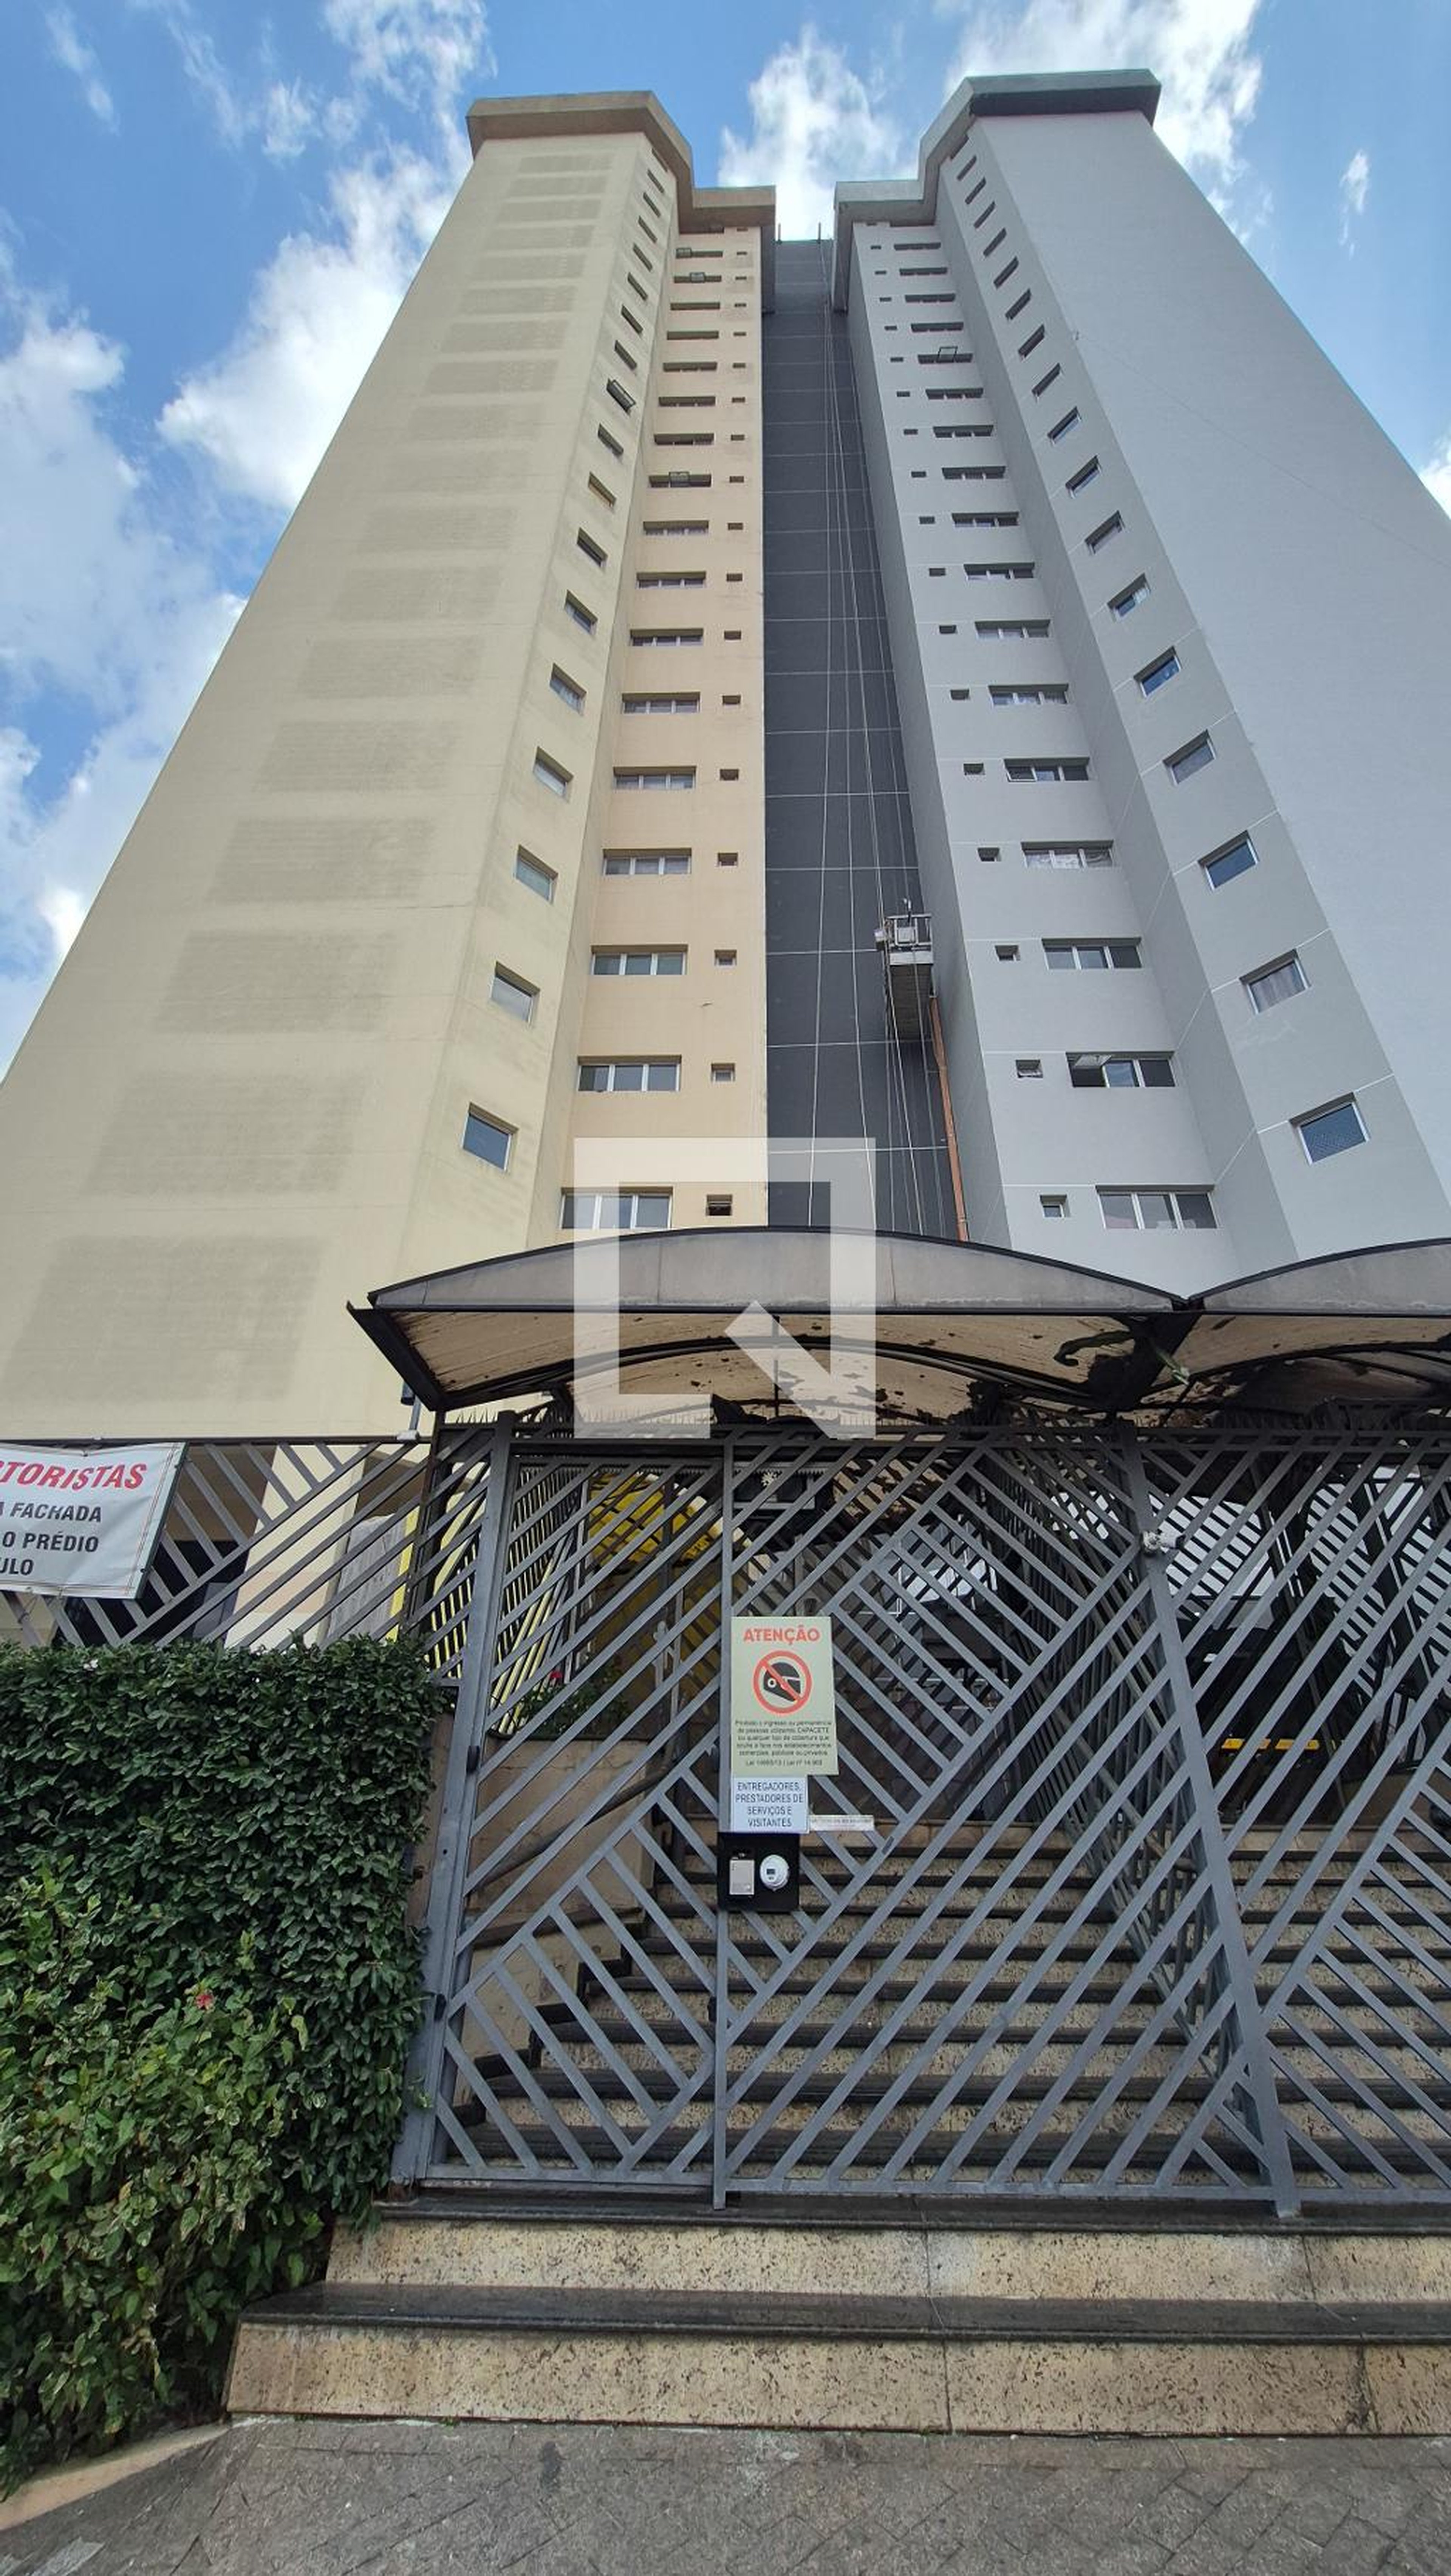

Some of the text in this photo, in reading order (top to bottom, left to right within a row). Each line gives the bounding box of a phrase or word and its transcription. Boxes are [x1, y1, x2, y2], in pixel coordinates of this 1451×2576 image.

[0, 1461, 147, 1491] TORISTAS
[10, 1503, 101, 1522] FACHADA
[23, 1531, 99, 1552] PRÉDIO
[743, 1625, 820, 1645] ATENÇÃO
[735, 1794, 803, 1803] PRESTADORES DE
[747, 1806, 792, 1815] SERVIÇOS E
[748, 1818, 792, 1827] VISITANTES
